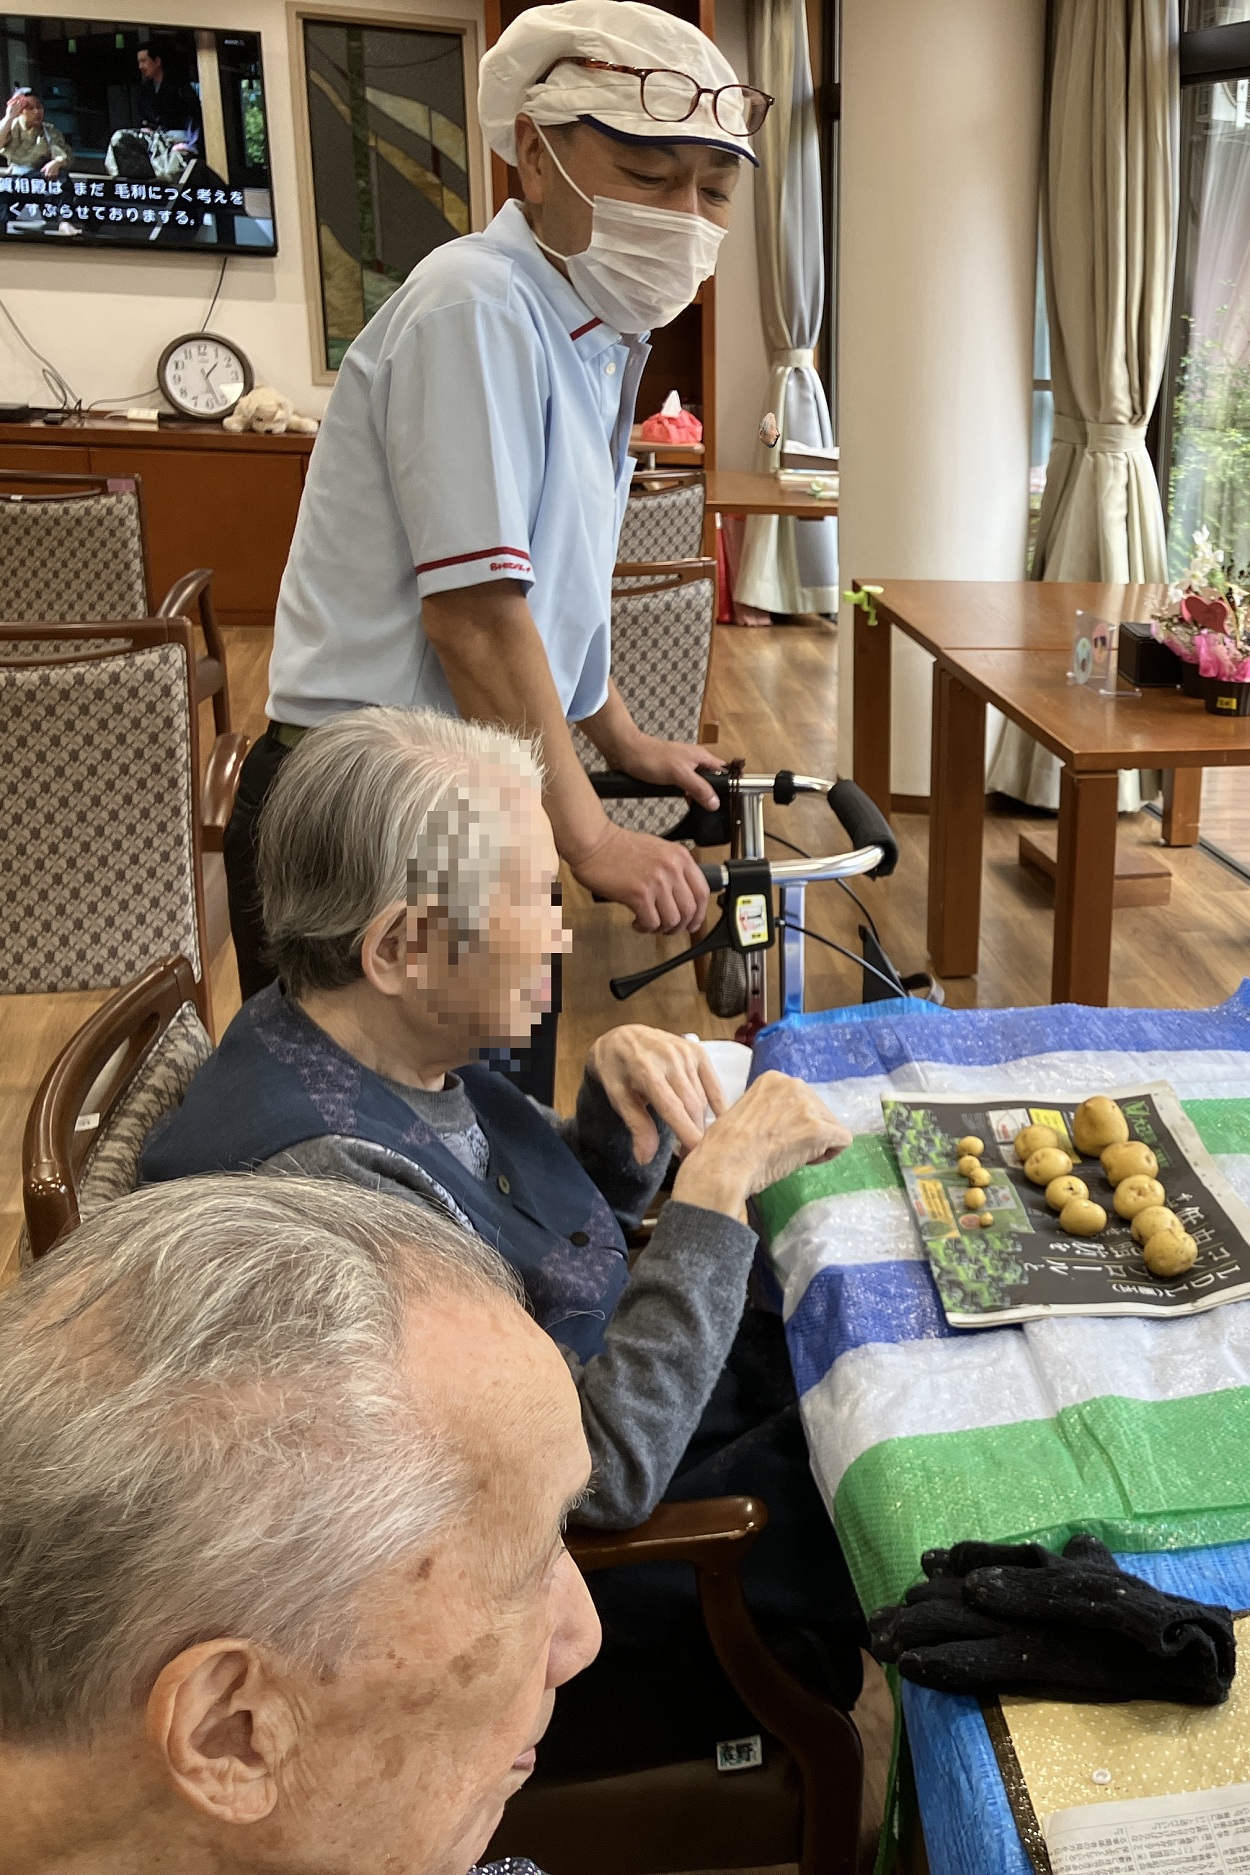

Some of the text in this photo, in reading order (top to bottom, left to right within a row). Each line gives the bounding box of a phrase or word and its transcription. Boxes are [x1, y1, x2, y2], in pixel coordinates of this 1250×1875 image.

[73, 181, 105, 198] まだ
[113, 183, 244, 206] 毛利につく考えを
[9, 202, 196, 226] くすぶらせておりまする。
